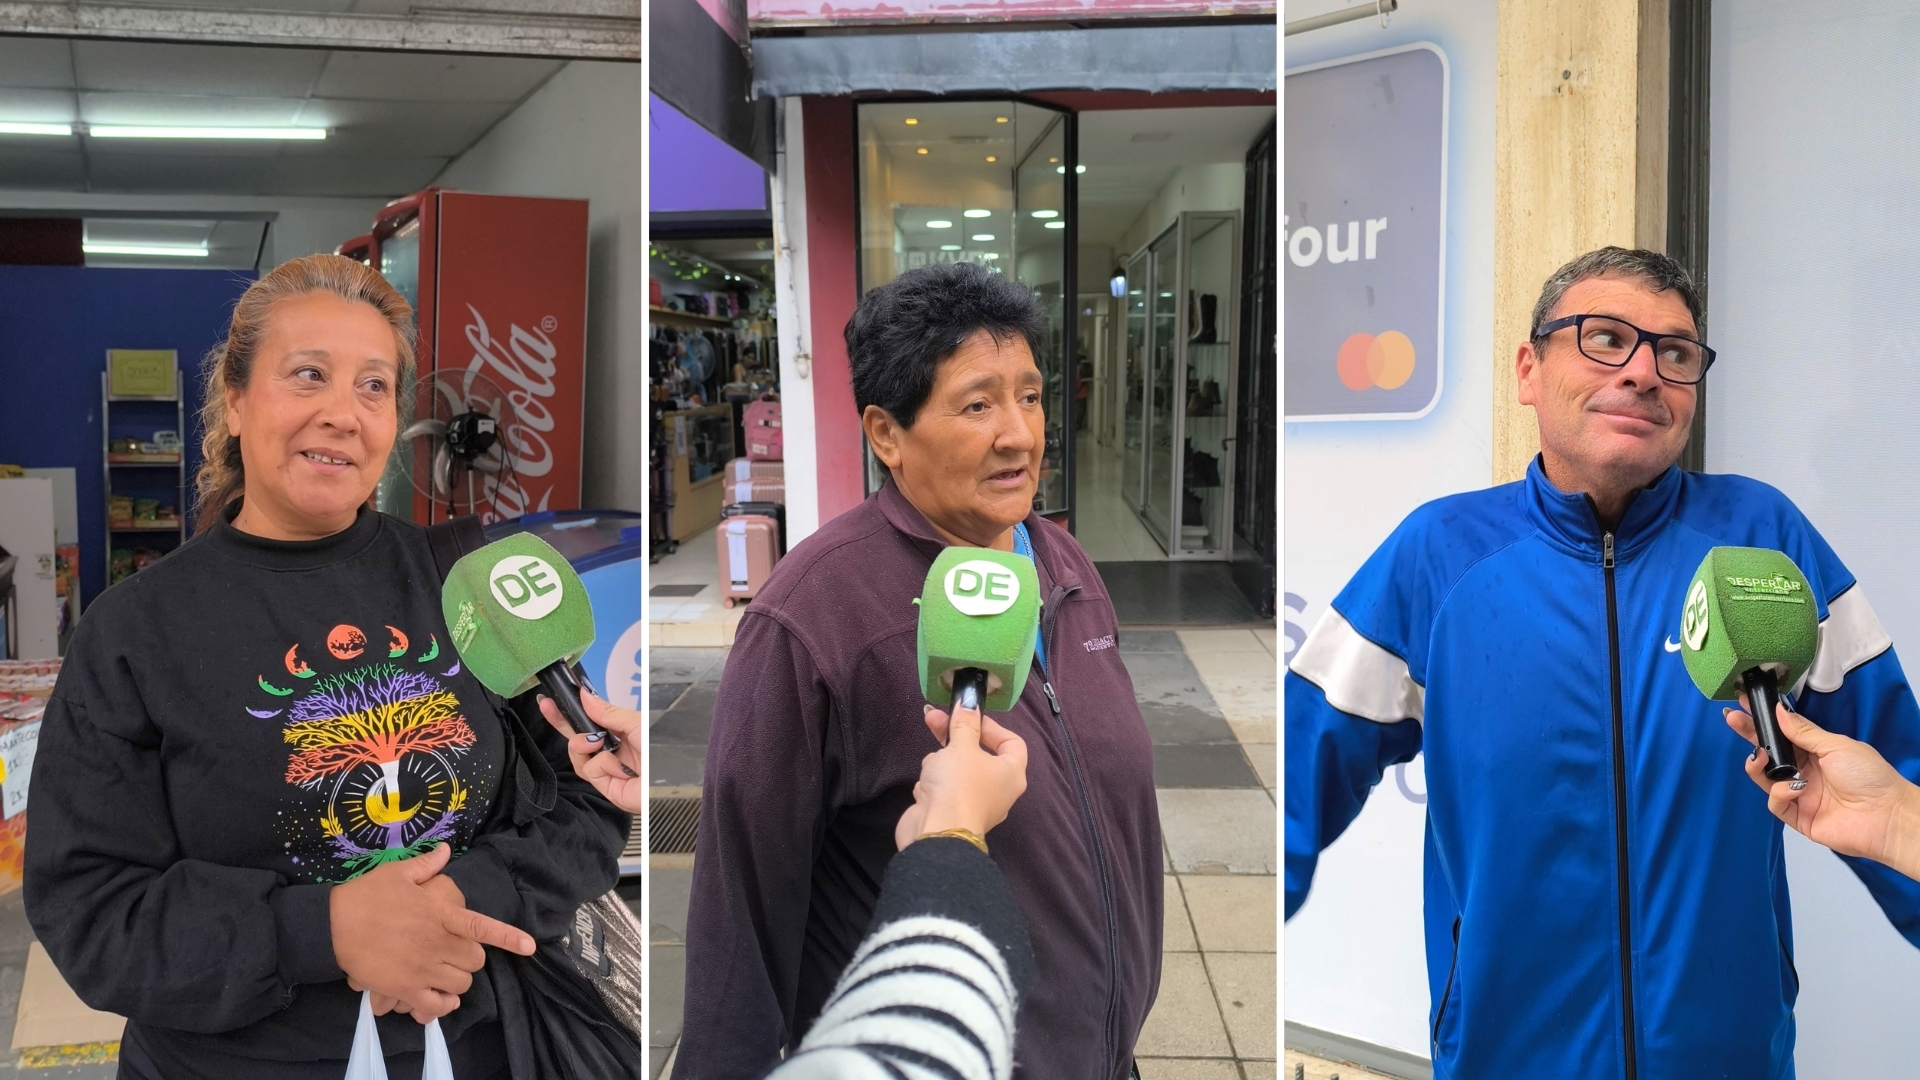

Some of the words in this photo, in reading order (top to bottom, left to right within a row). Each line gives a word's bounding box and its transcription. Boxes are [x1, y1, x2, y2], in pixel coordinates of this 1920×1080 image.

[493, 560, 557, 608] DE
[952, 569, 1011, 601] DE
[1685, 585, 1707, 641] DE
